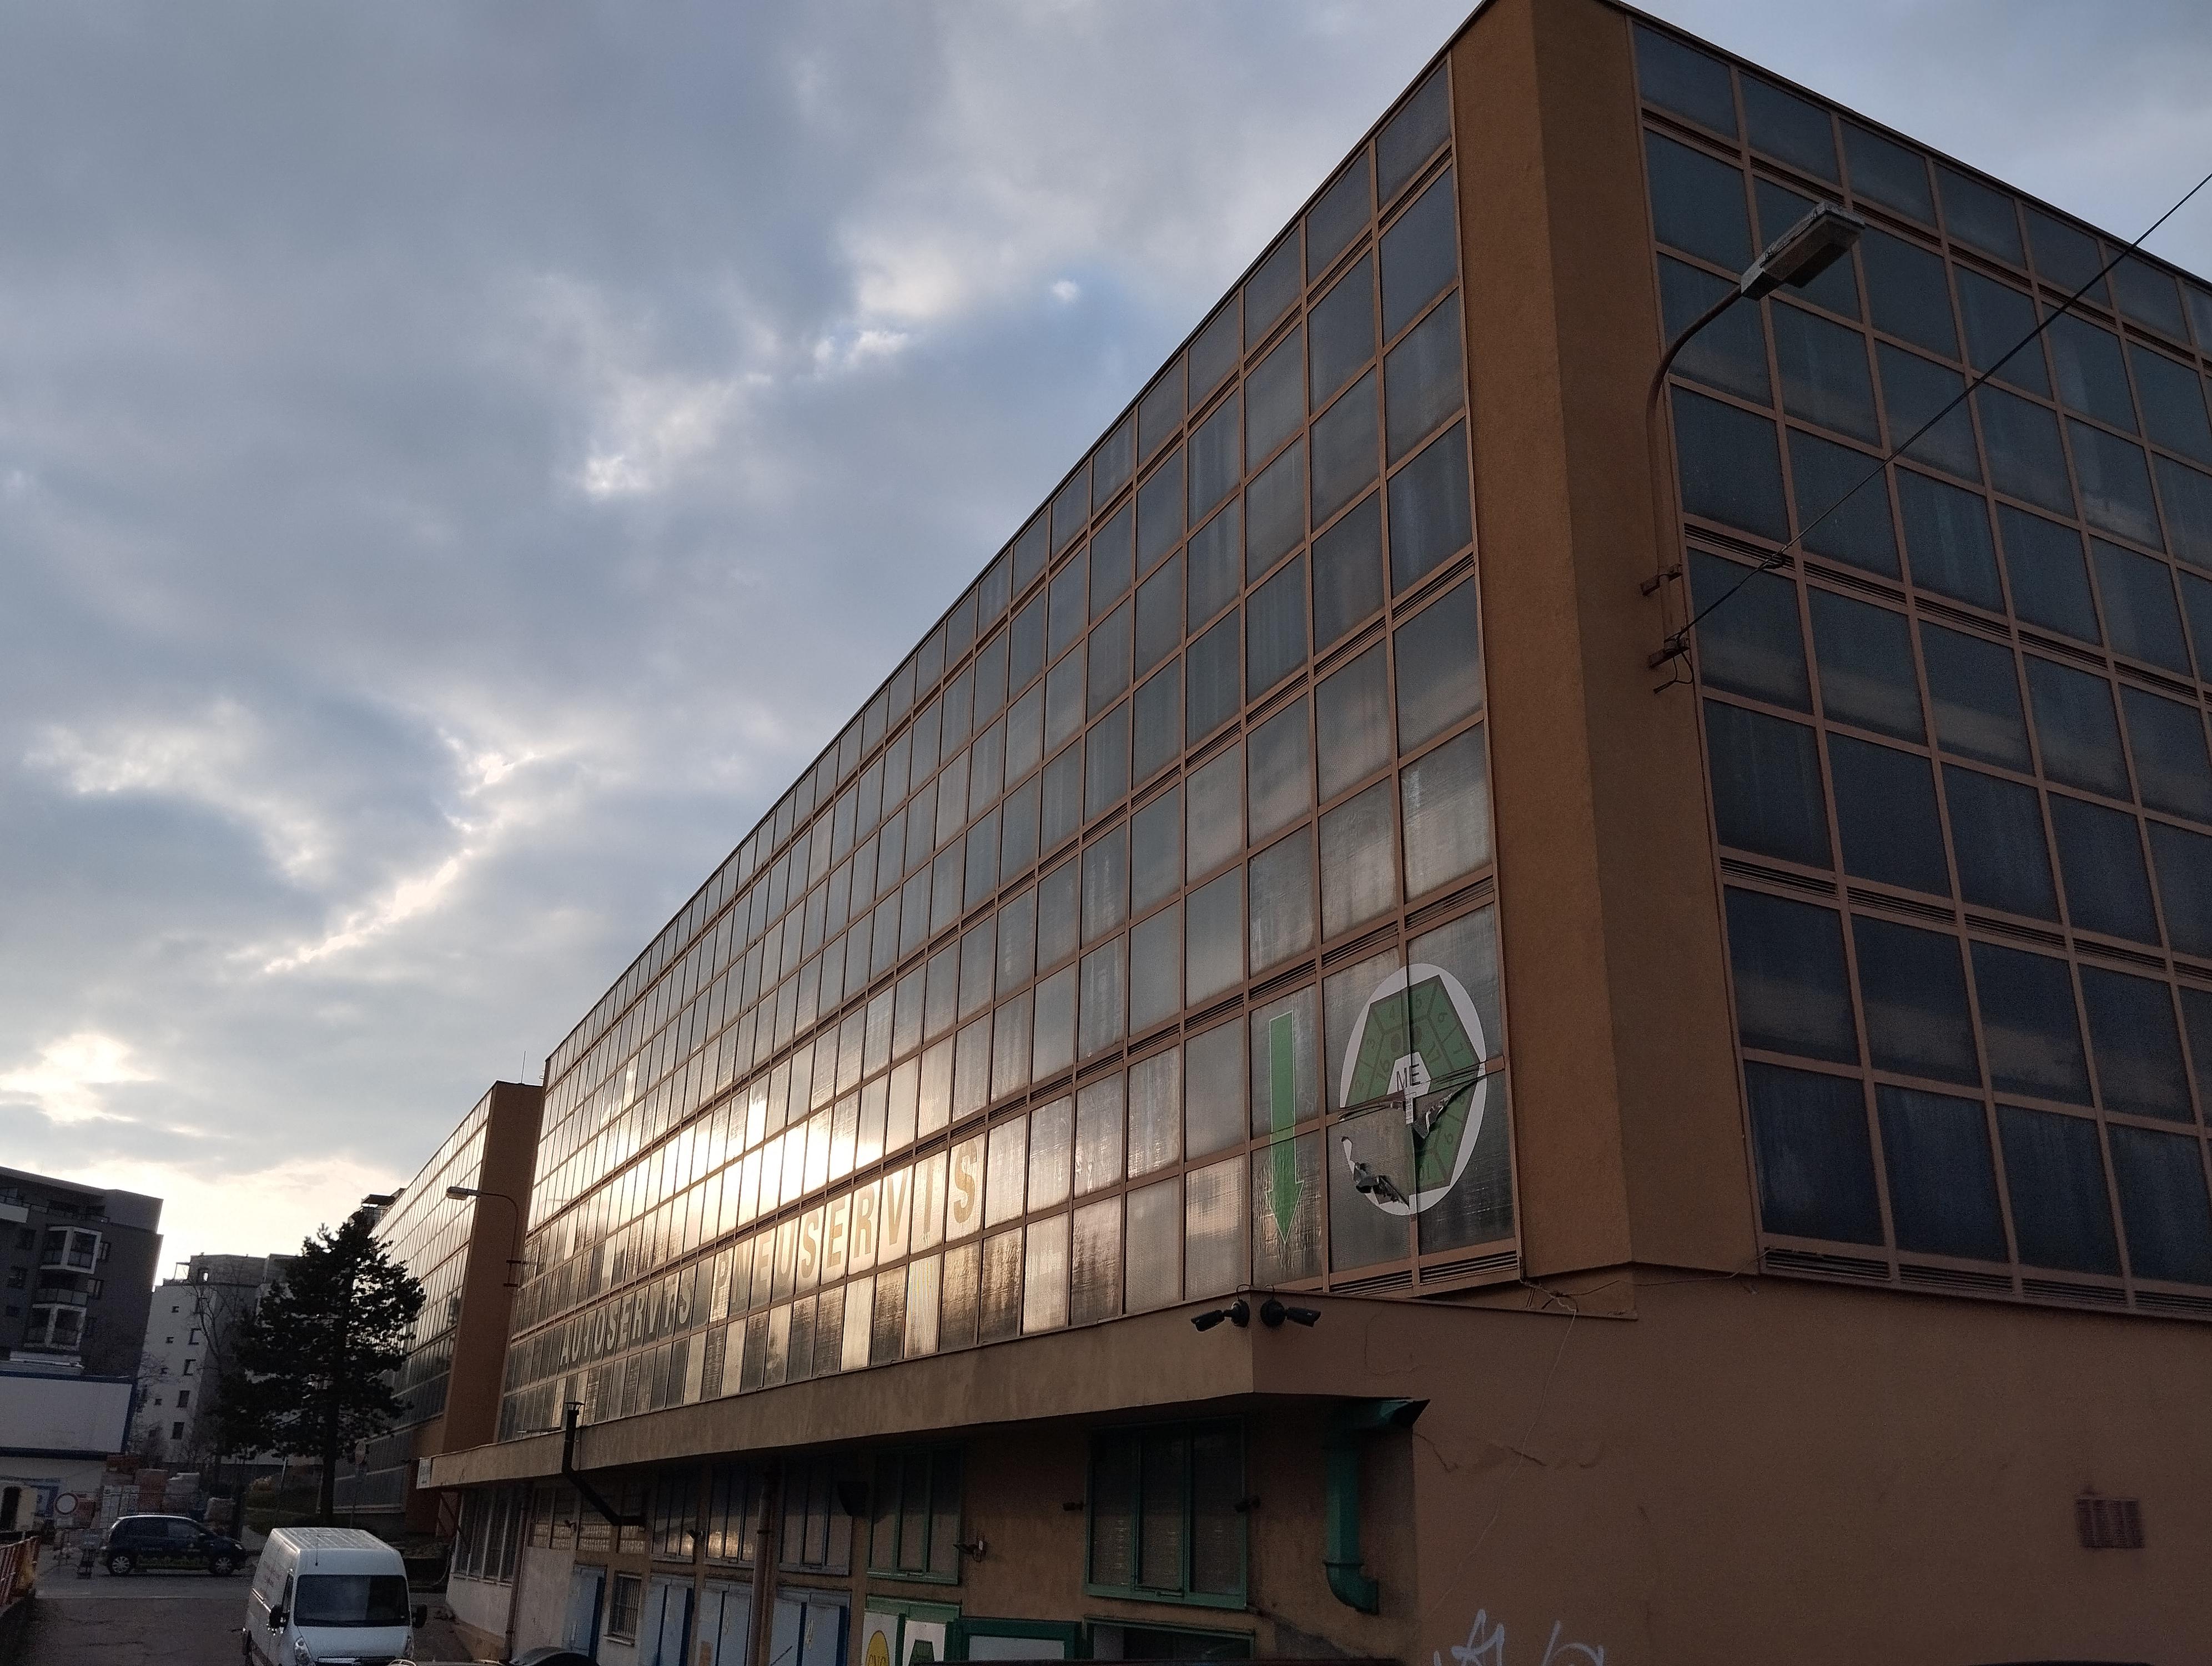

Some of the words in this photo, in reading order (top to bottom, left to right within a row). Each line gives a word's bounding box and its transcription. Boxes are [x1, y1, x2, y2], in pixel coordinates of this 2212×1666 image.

[1389, 1005, 1396, 1020] 4
[1437, 1012, 1447, 1023] 6
[1366, 1038, 1375, 1050] 3
[1426, 1041, 1441, 1063] 17
[1453, 1042, 1464, 1055] 7
[1376, 1059, 1390, 1082] 16
[1396, 1063, 1420, 1092] ME
[713, 1139, 978, 1309] PNEUSERVIS
[560, 1272, 691, 1367] AUTOSERVIS
